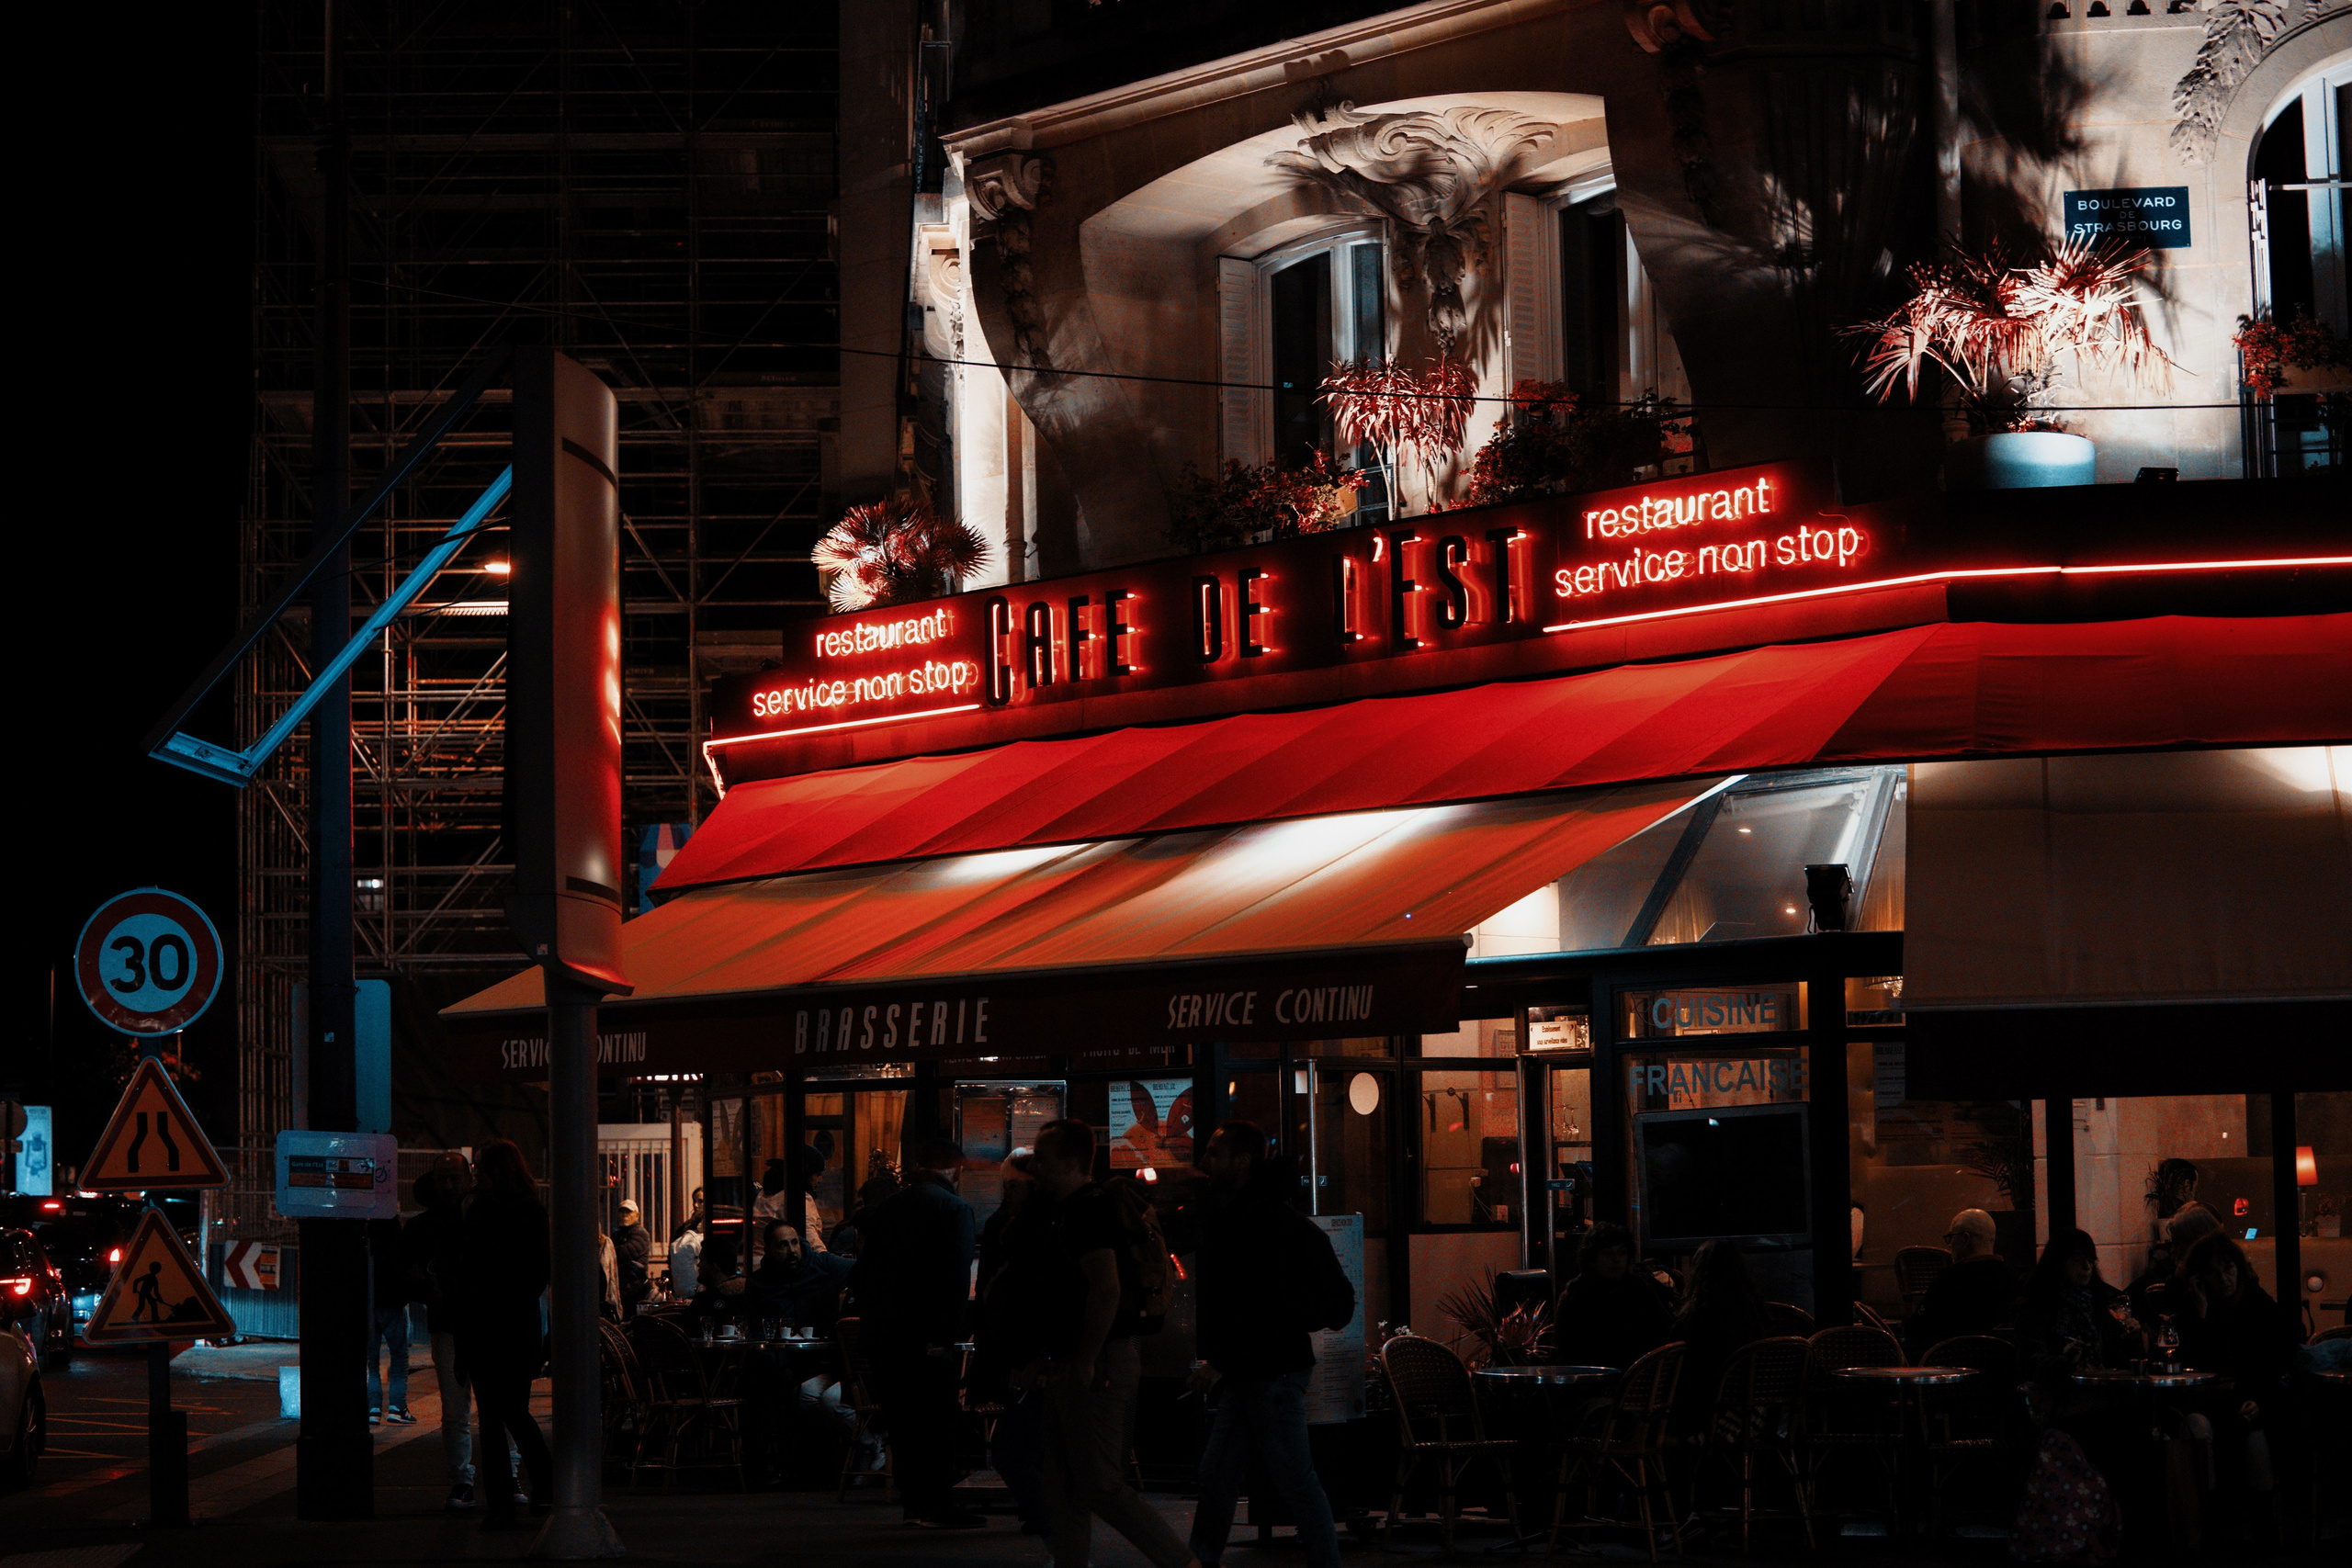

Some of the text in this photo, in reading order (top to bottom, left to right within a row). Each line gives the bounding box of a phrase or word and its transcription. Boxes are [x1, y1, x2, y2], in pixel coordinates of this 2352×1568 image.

[2074, 219, 2182, 234] STRASBOURG
[2077, 197, 2176, 210] BOULEVARD
[1585, 477, 1772, 540] restaurant
[1555, 524, 1860, 599] service non stop
[815, 607, 947, 659] restaurant
[984, 526, 1527, 706] CAFE DE L'EST
[752, 660, 969, 718] service non stop
[109, 933, 188, 993] 30
[794, 997, 990, 1055] BRASSERIE
[1168, 985, 1373, 1030] SERVICE CONTINU
[1653, 993, 1779, 1030] CUISINE
[502, 1032, 647, 1068] SERVI ONTINU
[1629, 1058, 1809, 1096] FRANCAISE
